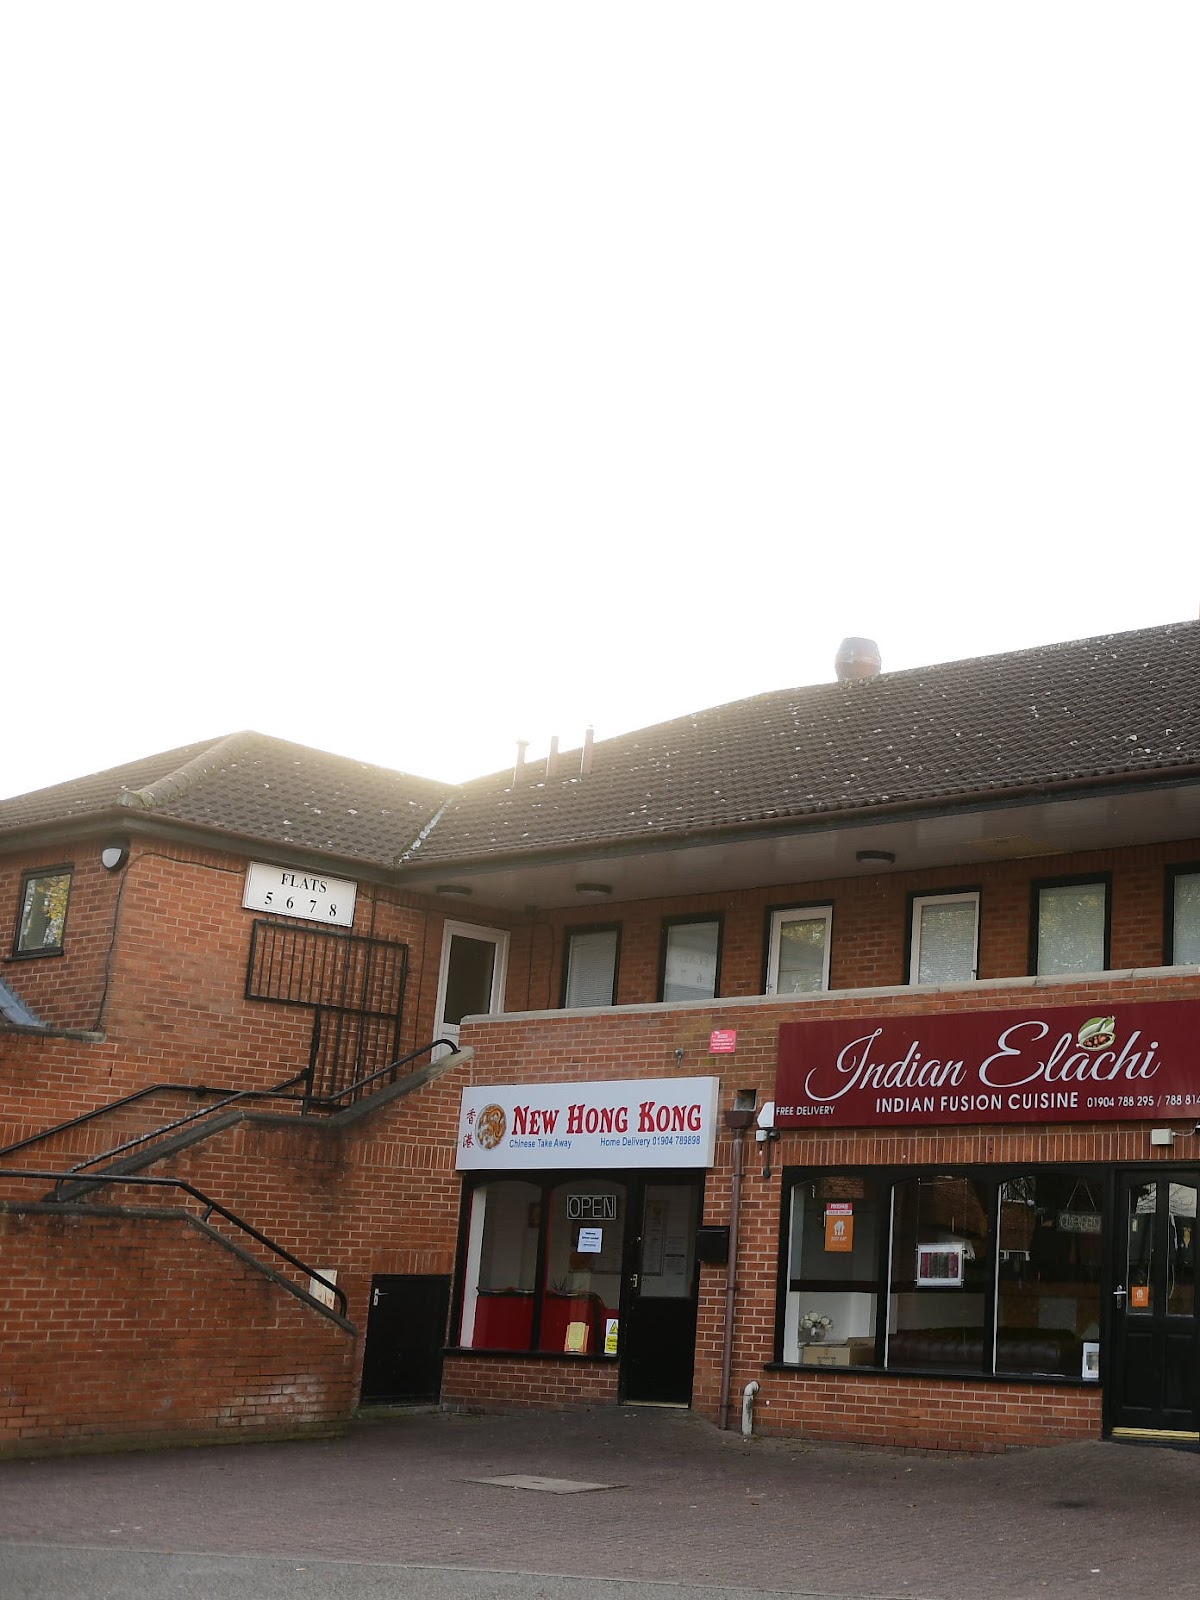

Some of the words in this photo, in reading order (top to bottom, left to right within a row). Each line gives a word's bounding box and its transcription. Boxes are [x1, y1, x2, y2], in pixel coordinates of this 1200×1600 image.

[281, 873, 328, 893] FLATS
[264, 891, 274, 905] 5
[286, 896, 294, 909] 6
[309, 899, 317, 913] 7
[329, 903, 337, 917] 8
[804, 1027, 967, 1102] Indian
[978, 1020, 1162, 1089] Elachi
[776, 1106, 794, 1116] FREE
[796, 1105, 836, 1116] DELIVERY
[875, 1096, 934, 1113] INDIAN
[940, 1094, 1001, 1112] FUSION
[1008, 1091, 1079, 1110] CUISINE
[1087, 1096, 1115, 1108] 01904
[1117, 1096, 1135, 1107] 788
[1136, 1095, 1154, 1107] 295
[1165, 1095, 1182, 1106] 788
[511, 1105, 560, 1136] NEW
[566, 1103, 628, 1134] HONG
[637, 1101, 701, 1133] KONG
[509, 1139, 536, 1149] Chinese
[538, 1138, 553, 1148] Take
[553, 1138, 572, 1149] Away
[600, 1137, 621, 1147] Home
[622, 1136, 651, 1148] Delivery
[652, 1136, 673, 1146] 01904
[675, 1135, 701, 1145] 789898
[569, 1197, 614, 1218] OPEN
